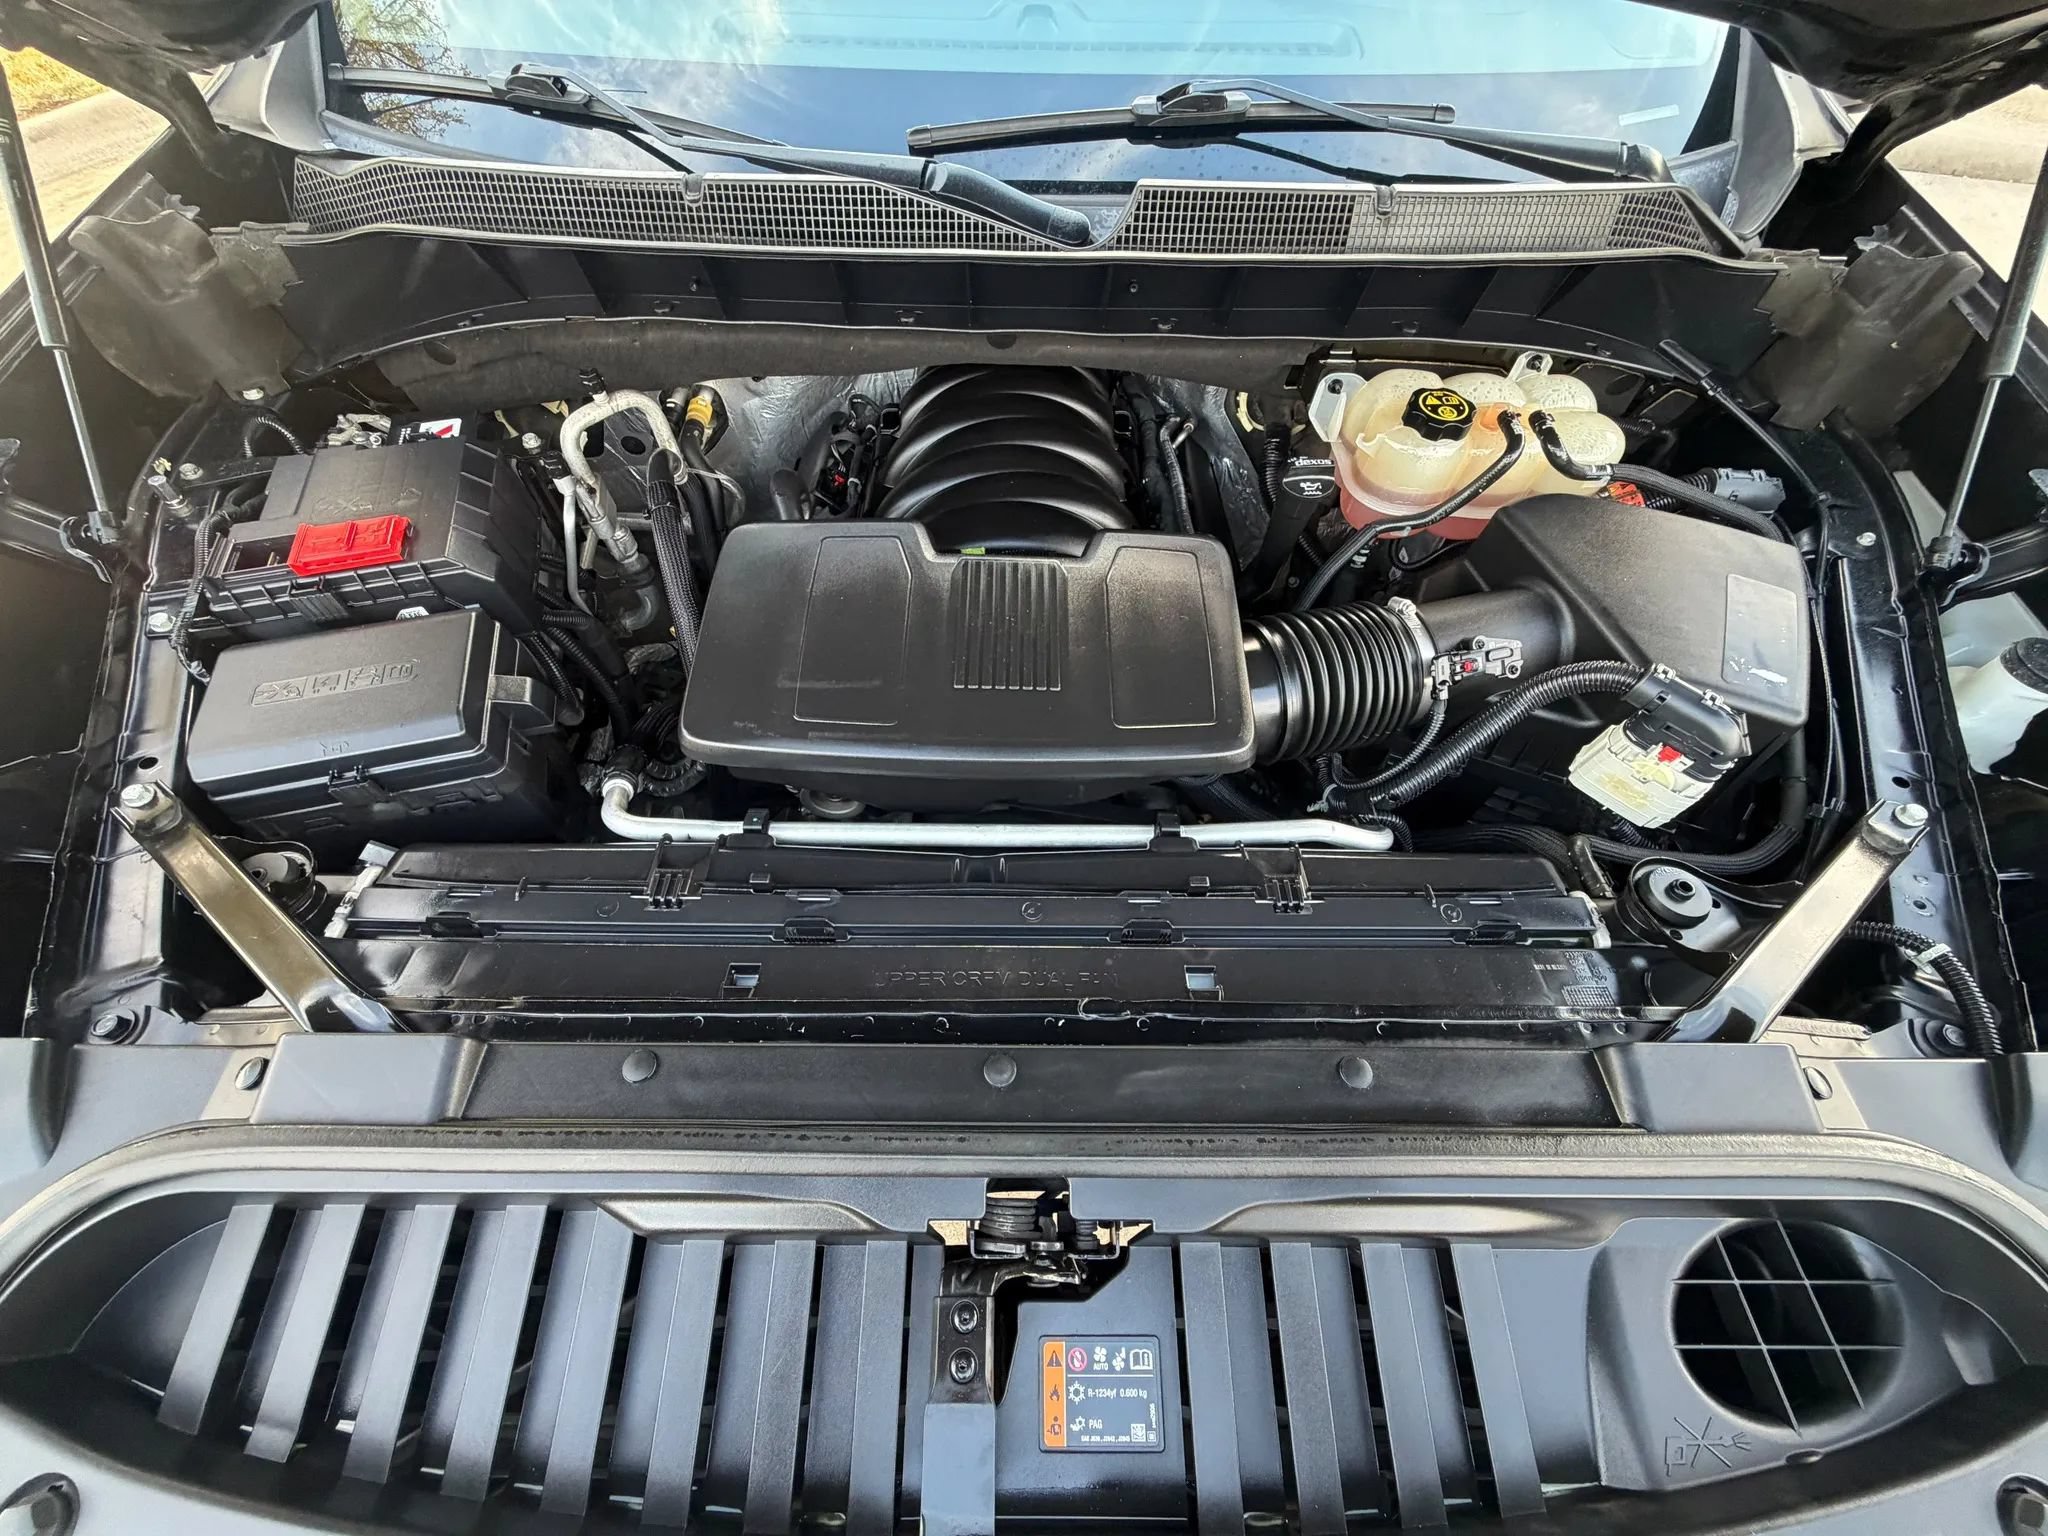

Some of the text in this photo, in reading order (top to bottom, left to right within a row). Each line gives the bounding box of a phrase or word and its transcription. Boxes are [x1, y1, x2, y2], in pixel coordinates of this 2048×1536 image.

[1295, 458, 1332, 466] dexos
[874, 970, 947, 987] UPPER
[1093, 1363, 1109, 1371] AUTO
[1087, 1388, 1148, 1399] R-1234yf 0.600 kg
[1088, 1419, 1103, 1430] PAG
